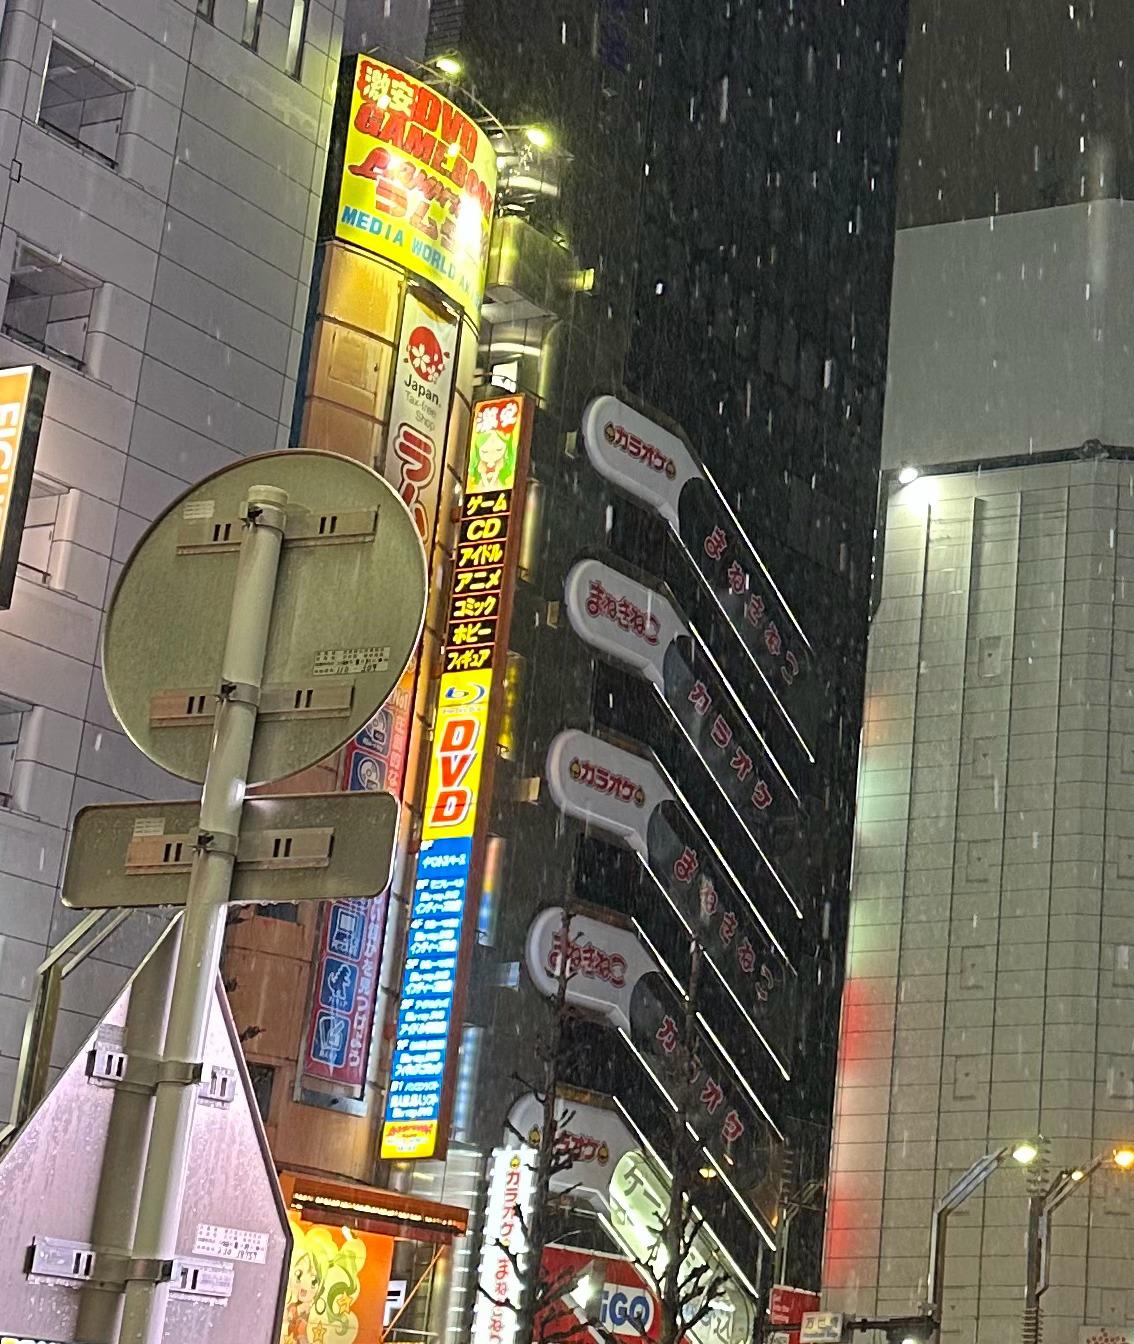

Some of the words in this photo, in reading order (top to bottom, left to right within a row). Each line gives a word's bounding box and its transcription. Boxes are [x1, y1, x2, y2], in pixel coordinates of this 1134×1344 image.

[412, 86, 478, 163] DVD
[341, 205, 404, 247] MEDIA
[411, 237, 457, 286] WORLD
[404, 390, 437, 419] Tax-free
[415, 410, 436, 431] Shop
[614, 425, 667, 475] カラオケ
[466, 493, 508, 516] ゲーム
[466, 520, 502, 541] CD
[457, 541, 503, 567] アイドル
[455, 567, 502, 593] アニメ
[452, 594, 497, 618] コミック
[585, 579, 661, 646] まねきねこ
[452, 621, 492, 645] ホビー
[446, 647, 491, 671] フィギュア
[687, 679, 773, 810] カラオケ
[429, 718, 481, 828] DVD
[579, 759, 636, 803] カラオケ
[601, 1290, 650, 1327] iGO
